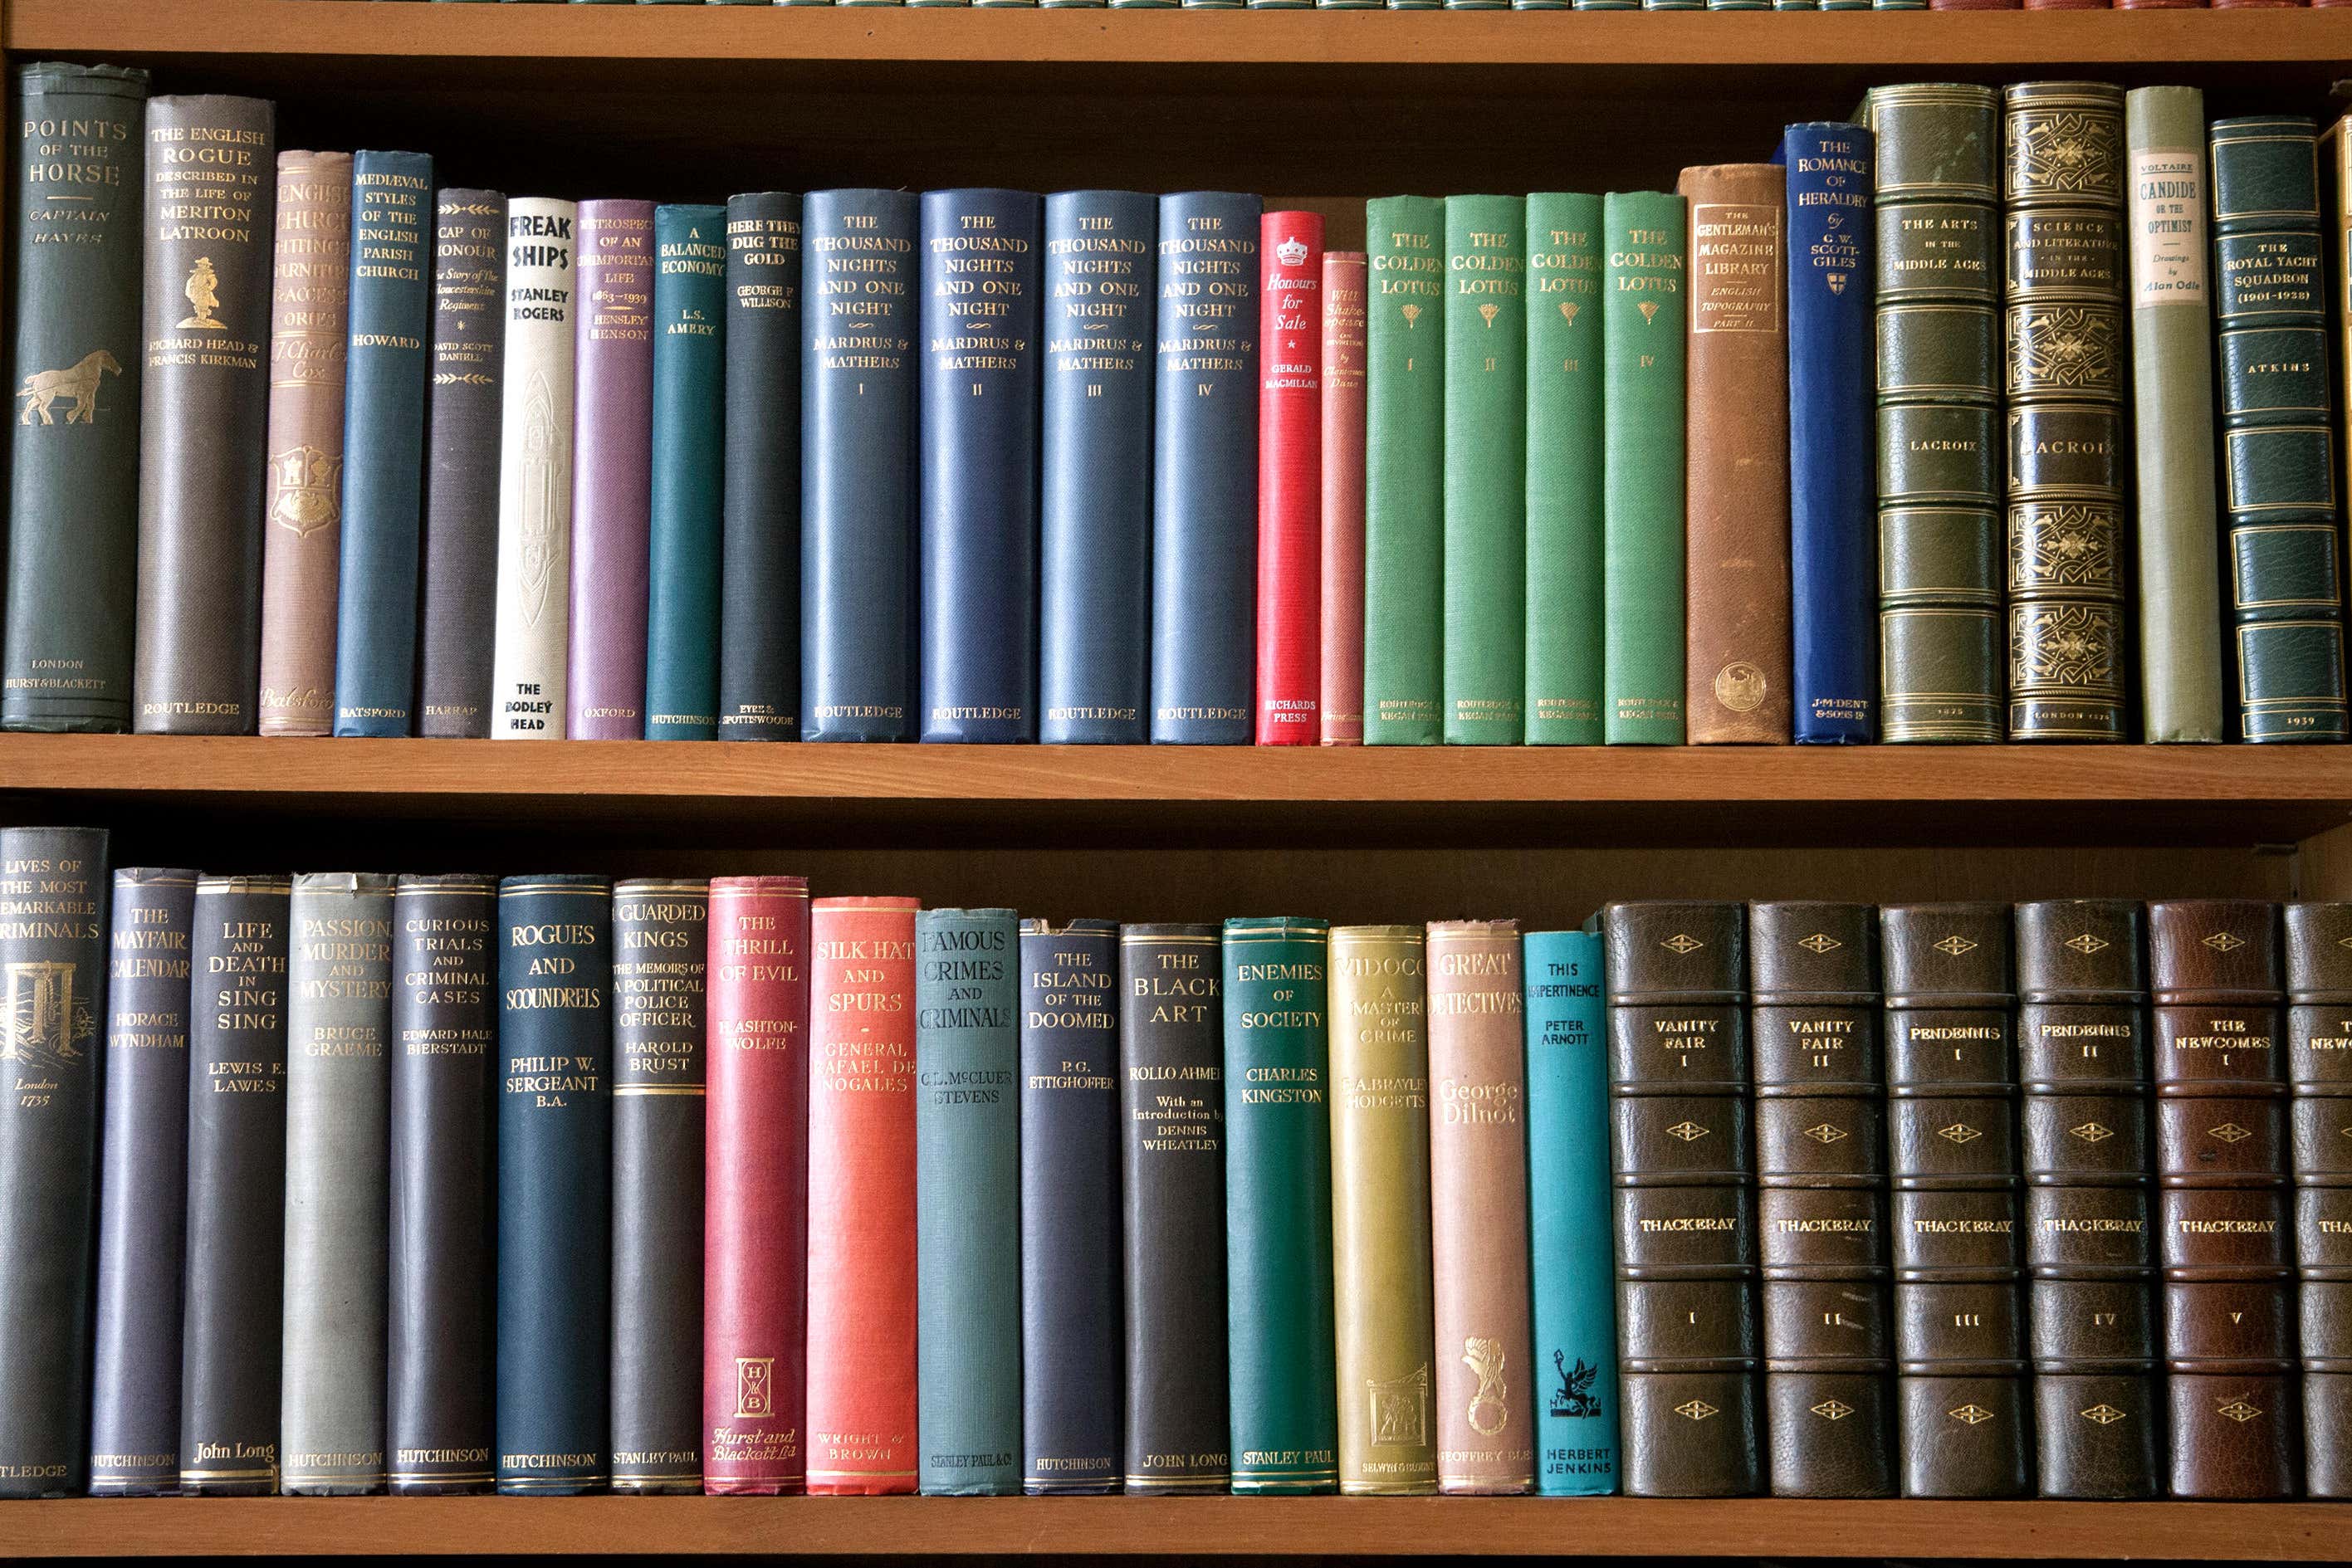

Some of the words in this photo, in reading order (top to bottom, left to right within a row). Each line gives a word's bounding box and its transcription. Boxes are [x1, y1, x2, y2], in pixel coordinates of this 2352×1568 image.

[24, 120, 127, 140] POINTS
[152, 129, 183, 142] THE
[191, 129, 266, 145] ENGLISH
[40, 144, 61, 156] OF
[70, 144, 108, 158] THE
[1820, 141, 1850, 154] THE
[163, 149, 252, 166] ROGUE
[1798, 159, 1867, 174] ROMANCE
[29, 164, 120, 185] HORSE
[355, 174, 428, 190] MEDIÆVAL
[2140, 181, 2196, 200] CANDIDE
[365, 193, 416, 206] STYLES
[1798, 193, 1868, 208] HERALDRY
[161, 206, 251, 221] MERITON
[362, 211, 380, 221] OF
[389, 212, 417, 225] THE
[510, 216, 571, 239] FREAK
[843, 216, 878, 229] THE
[1902, 219, 1934, 231] THE
[1940, 220, 1978, 230] ARTS
[2033, 222, 2104, 233] SCIENCE
[2148, 219, 2192, 233] OPTIMIST
[160, 227, 250, 242] LATROON
[359, 229, 418, 244] ENGLISH
[660, 244, 726, 259] BALANCED
[813, 238, 911, 253] THOUSAND
[1699, 244, 1773, 256] MAGAZINE
[364, 247, 413, 261] PARISH
[513, 247, 568, 270] SHIPS
[744, 253, 785, 266] GOLD
[2153, 254, 2189, 263] Drawings
[662, 261, 723, 276] ECONOMY
[827, 259, 897, 273] NIGHTS
[1373, 255, 1444, 273] GOLDEN
[1705, 263, 1768, 275] LIBRARY
[1813, 256, 1856, 268] GILES
[1893, 260, 1947, 271] MIDDLE
[1953, 260, 1987, 271] AGES
[2227, 257, 2271, 271] ROYAL
[2276, 257, 2317, 267] YACHT
[357, 266, 418, 280] CHURCH
[1267, 274, 1317, 291] Honours
[1381, 280, 1440, 296] LOTUS
[2144, 281, 2173, 291] Alan
[2176, 281, 2200, 291] Odle
[2234, 275, 2309, 287] SQUADRON
[818, 281, 857, 296] AND
[865, 281, 905, 296] ONE
[511, 289, 568, 303] STANLEY
[1282, 294, 1302, 310] for
[513, 307, 565, 320] ROGERS
[830, 302, 892, 316] NIGHT
[1701, 302, 1771, 312] TOPOGRAPHY
[667, 324, 714, 335] AMERY
[1274, 315, 1306, 330] Sale
[354, 335, 419, 349] HOWARD
[2248, 363, 2310, 373] ATKINS
[517, 684, 540, 695] THE
[144, 703, 240, 716] ROUTLEDGE
[340, 707, 405, 719] BATSFORD
[506, 701, 553, 714] BODLEY
[1265, 701, 1316, 711] RICHARDS
[1049, 708, 1136, 720] ROUTLEDGE
[1274, 713, 1307, 723] PRESS
[2287, 716, 2315, 726] 1939
[511, 719, 545, 730] HEAD
[6, 861, 50, 872] LIVES
[59, 860, 81, 872] OF
[2, 881, 32, 893] THE
[40, 881, 87, 893] MOST
[130, 908, 169, 925] THE
[739, 916, 775, 931] THE
[223, 922, 272, 938] LIFE
[406, 921, 489, 933] CURIOUS
[113, 931, 187, 950] MAYFAIR
[511, 925, 595, 946] ROGUES
[623, 931, 688, 949] KINGS
[922, 931, 1005, 952] FAMOUS
[232, 943, 263, 952] AND
[414, 938, 483, 951] TRIALS
[723, 940, 793, 955] THRILL
[208, 956, 286, 973] DEATH
[433, 956, 463, 965] AND
[529, 958, 575, 975] AND
[1054, 954, 1092, 966] THE
[1158, 955, 1200, 969] THE
[1440, 954, 1510, 976] GREAT
[720, 967, 745, 982] OF
[752, 965, 798, 981] EVIL
[924, 961, 1004, 981] CRIMES
[1238, 965, 1322, 981] ENEMIES
[1548, 964, 1578, 975] THIS
[238, 977, 255, 986] IN
[405, 972, 489, 986] CRIMINAL
[1033, 973, 1112, 989] ISLAND
[1135, 978, 1220, 996] BLACK
[218, 990, 277, 1006] SING
[415, 991, 481, 1004] CASES
[506, 988, 600, 1009] SCOUNDRELS
[1045, 994, 1066, 1005] OF
[1073, 994, 1101, 1006] THE
[1274, 990, 1293, 1001] OF
[624, 997, 688, 1009] POLICE
[829, 994, 902, 1012] SPURS
[218, 1013, 276, 1029] SING
[620, 1013, 696, 1028] OFFICER
[1029, 1012, 1114, 1028] DOOMED
[1150, 1005, 1207, 1023] ART
[1241, 1012, 1321, 1028] SOCIETY
[1546, 1021, 1584, 1031] PETER
[1655, 1020, 1718, 1033] VANITY
[2041, 1025, 2130, 1038] PENDENNIS
[2210, 1021, 2245, 1032] THE
[1542, 1034, 1588, 1044] ARNOTT
[1665, 1038, 1705, 1049] FAIR
[2176, 1038, 2271, 1049] NEWCOMES
[626, 1042, 693, 1056] HAROLD
[208, 1062, 262, 1075] LEWIS
[272, 1063, 286, 1074] E.
[511, 1058, 570, 1072] PHILIP
[575, 1057, 595, 1071] W.
[629, 1058, 689, 1073] BRUST
[1029, 1076, 1114, 1089] ETTIGHOFFER
[1246, 1069, 1318, 1082] CHARLES
[13, 1078, 58, 1092] London
[213, 1079, 276, 1092] LAWES
[506, 1077, 599, 1092] SERGEANT
[1241, 1088, 1322, 1103] KINGSTON
[1440, 1079, 1517, 1106] George
[21, 1094, 50, 1106] 1735
[536, 1096, 567, 1107] B.A.
[1156, 1096, 1186, 1106] With
[1191, 1098, 1203, 1106] an
[1441, 1103, 1515, 1122] Dilnot
[1157, 1126, 1207, 1136] DENNIS
[1142, 1140, 1220, 1150] WHEATLEY
[1641, 1219, 1736, 1232] THACKERAY
[2180, 1220, 2276, 1233] THACKERAY
[194, 1443, 231, 1463] John
[236, 1443, 275, 1462] Long
[398, 1448, 488, 1463] HUTCHINSON
[614, 1452, 666, 1463] STANLEY
[668, 1452, 697, 1463] PAUL
[1244, 1451, 1300, 1464] STANLEY
[1304, 1450, 1334, 1463] PAUL
[1547, 1448, 1610, 1459] HERBERT
[502, 1453, 596, 1468] HUTCHINSON
[1142, 1454, 1185, 1468] JOHN
[1191, 1454, 1228, 1468] LONG
[1547, 1463, 1612, 1473] JENKINS
